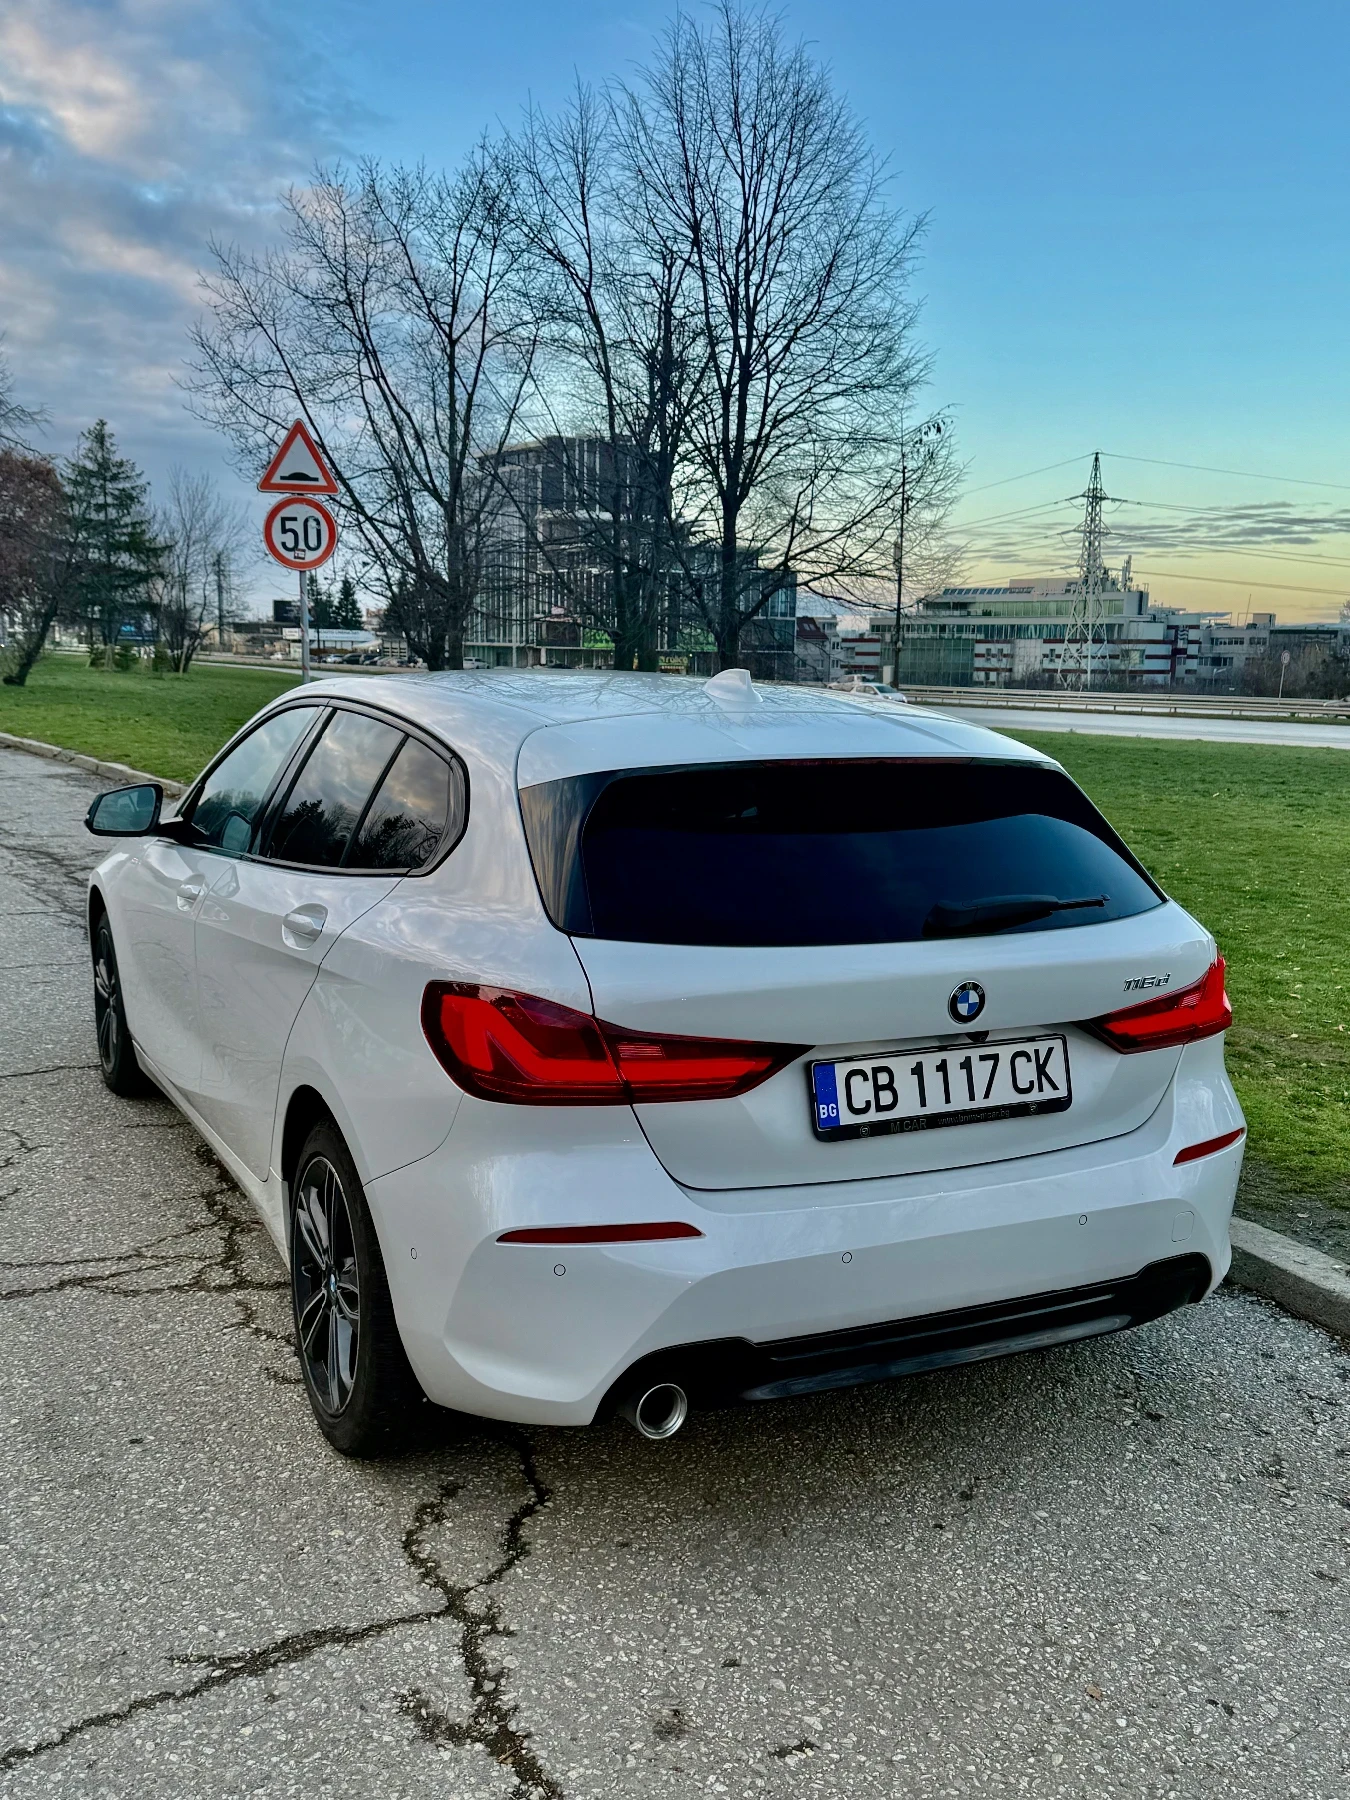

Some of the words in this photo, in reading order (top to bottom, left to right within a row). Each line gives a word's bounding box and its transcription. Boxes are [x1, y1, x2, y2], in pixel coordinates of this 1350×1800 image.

[281, 516, 322, 552] 50
[1123, 972, 1172, 992] 116d
[844, 1065, 899, 1116] CB
[910, 1053, 1000, 1108] 1117
[1009, 1046, 1060, 1095] CK
[819, 1103, 838, 1119] BG
[903, 1118, 927, 1131] CAR
